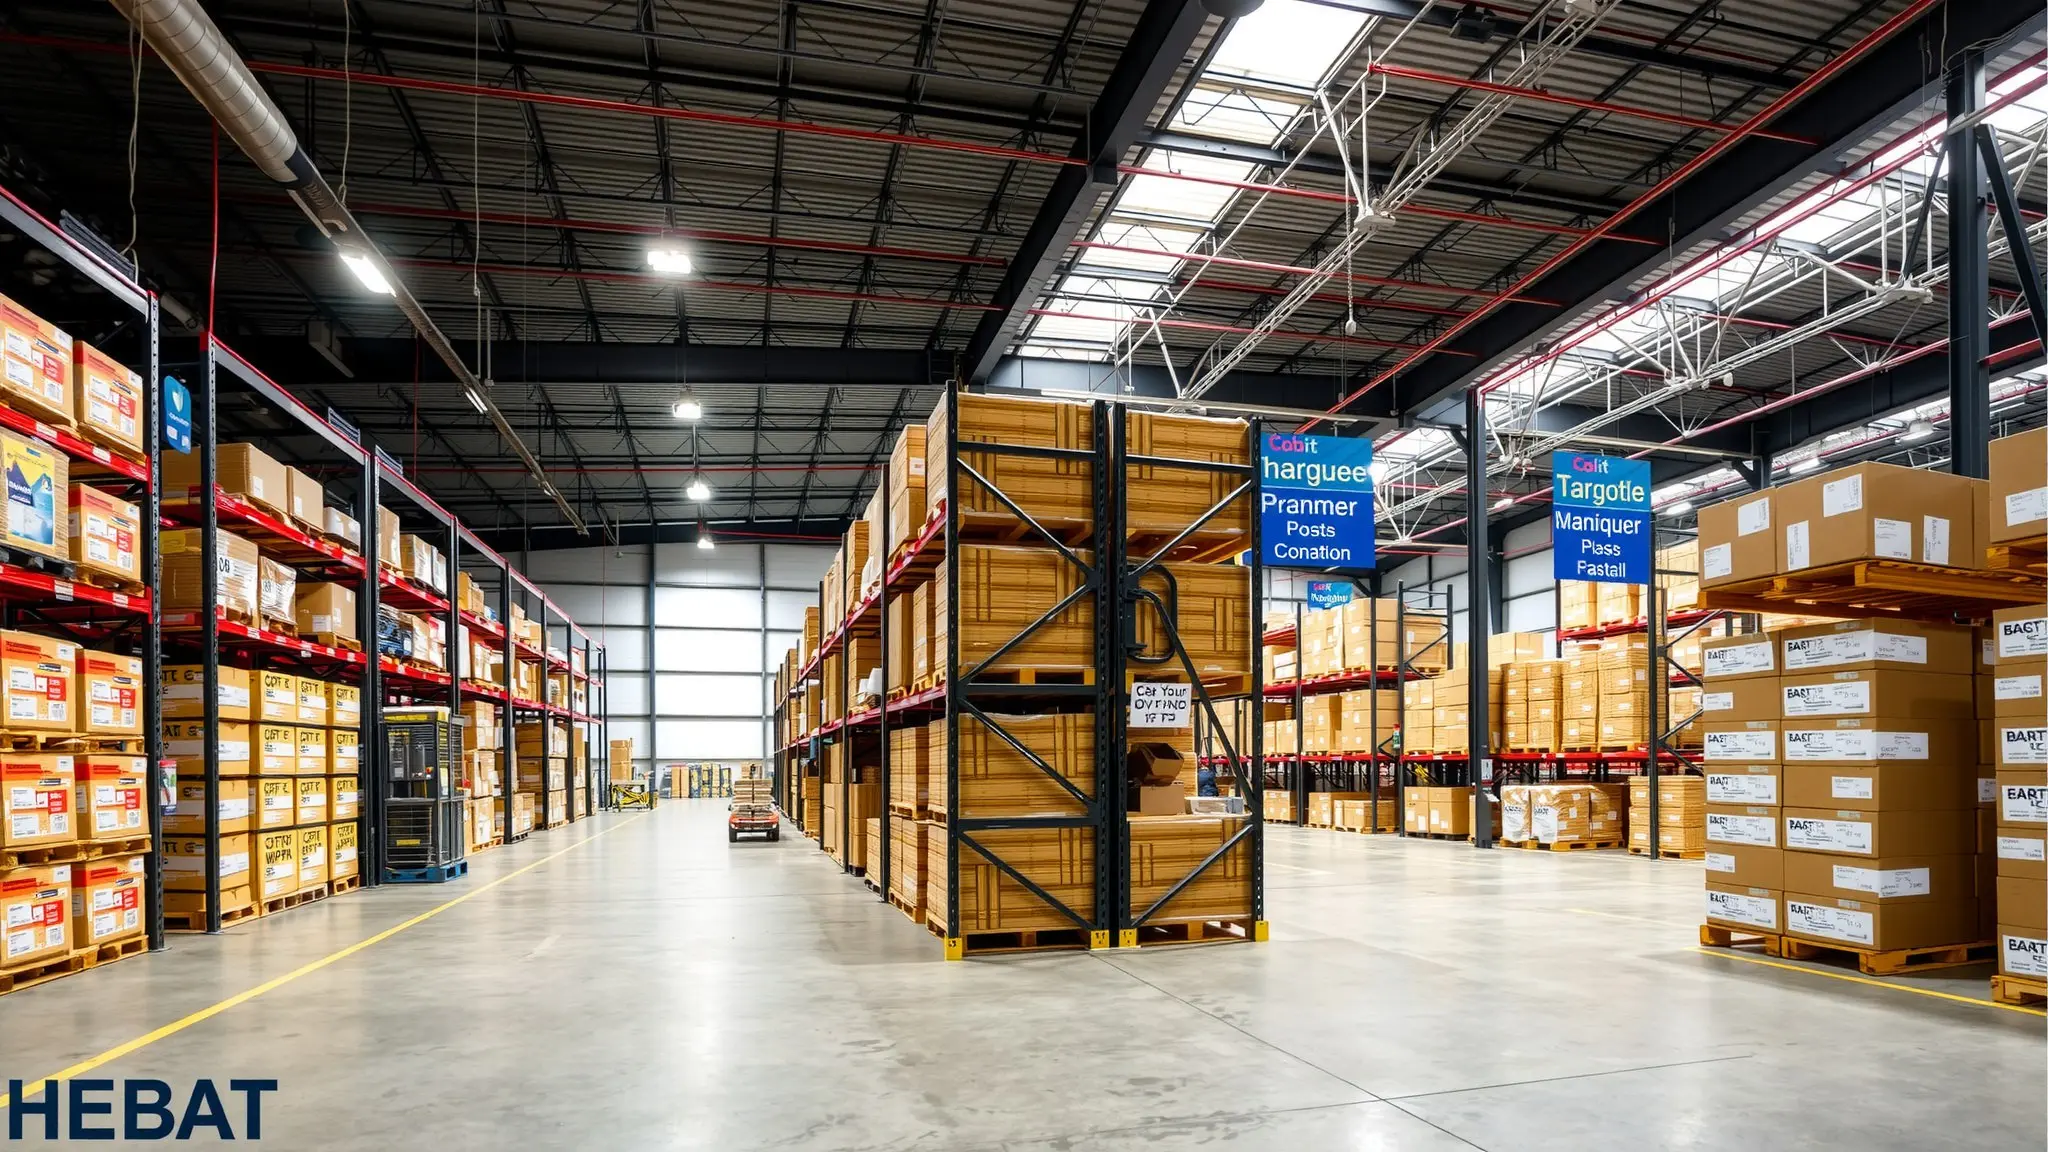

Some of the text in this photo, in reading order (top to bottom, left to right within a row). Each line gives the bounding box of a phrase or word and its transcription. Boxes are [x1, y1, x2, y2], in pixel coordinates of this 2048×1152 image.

[1261, 456, 1367, 486] harguee
[1261, 493, 1358, 516] Pranmer
[1287, 521, 1336, 537] Posts
[1555, 511, 1641, 537] Maniquer
[1274, 543, 1351, 561] Conation
